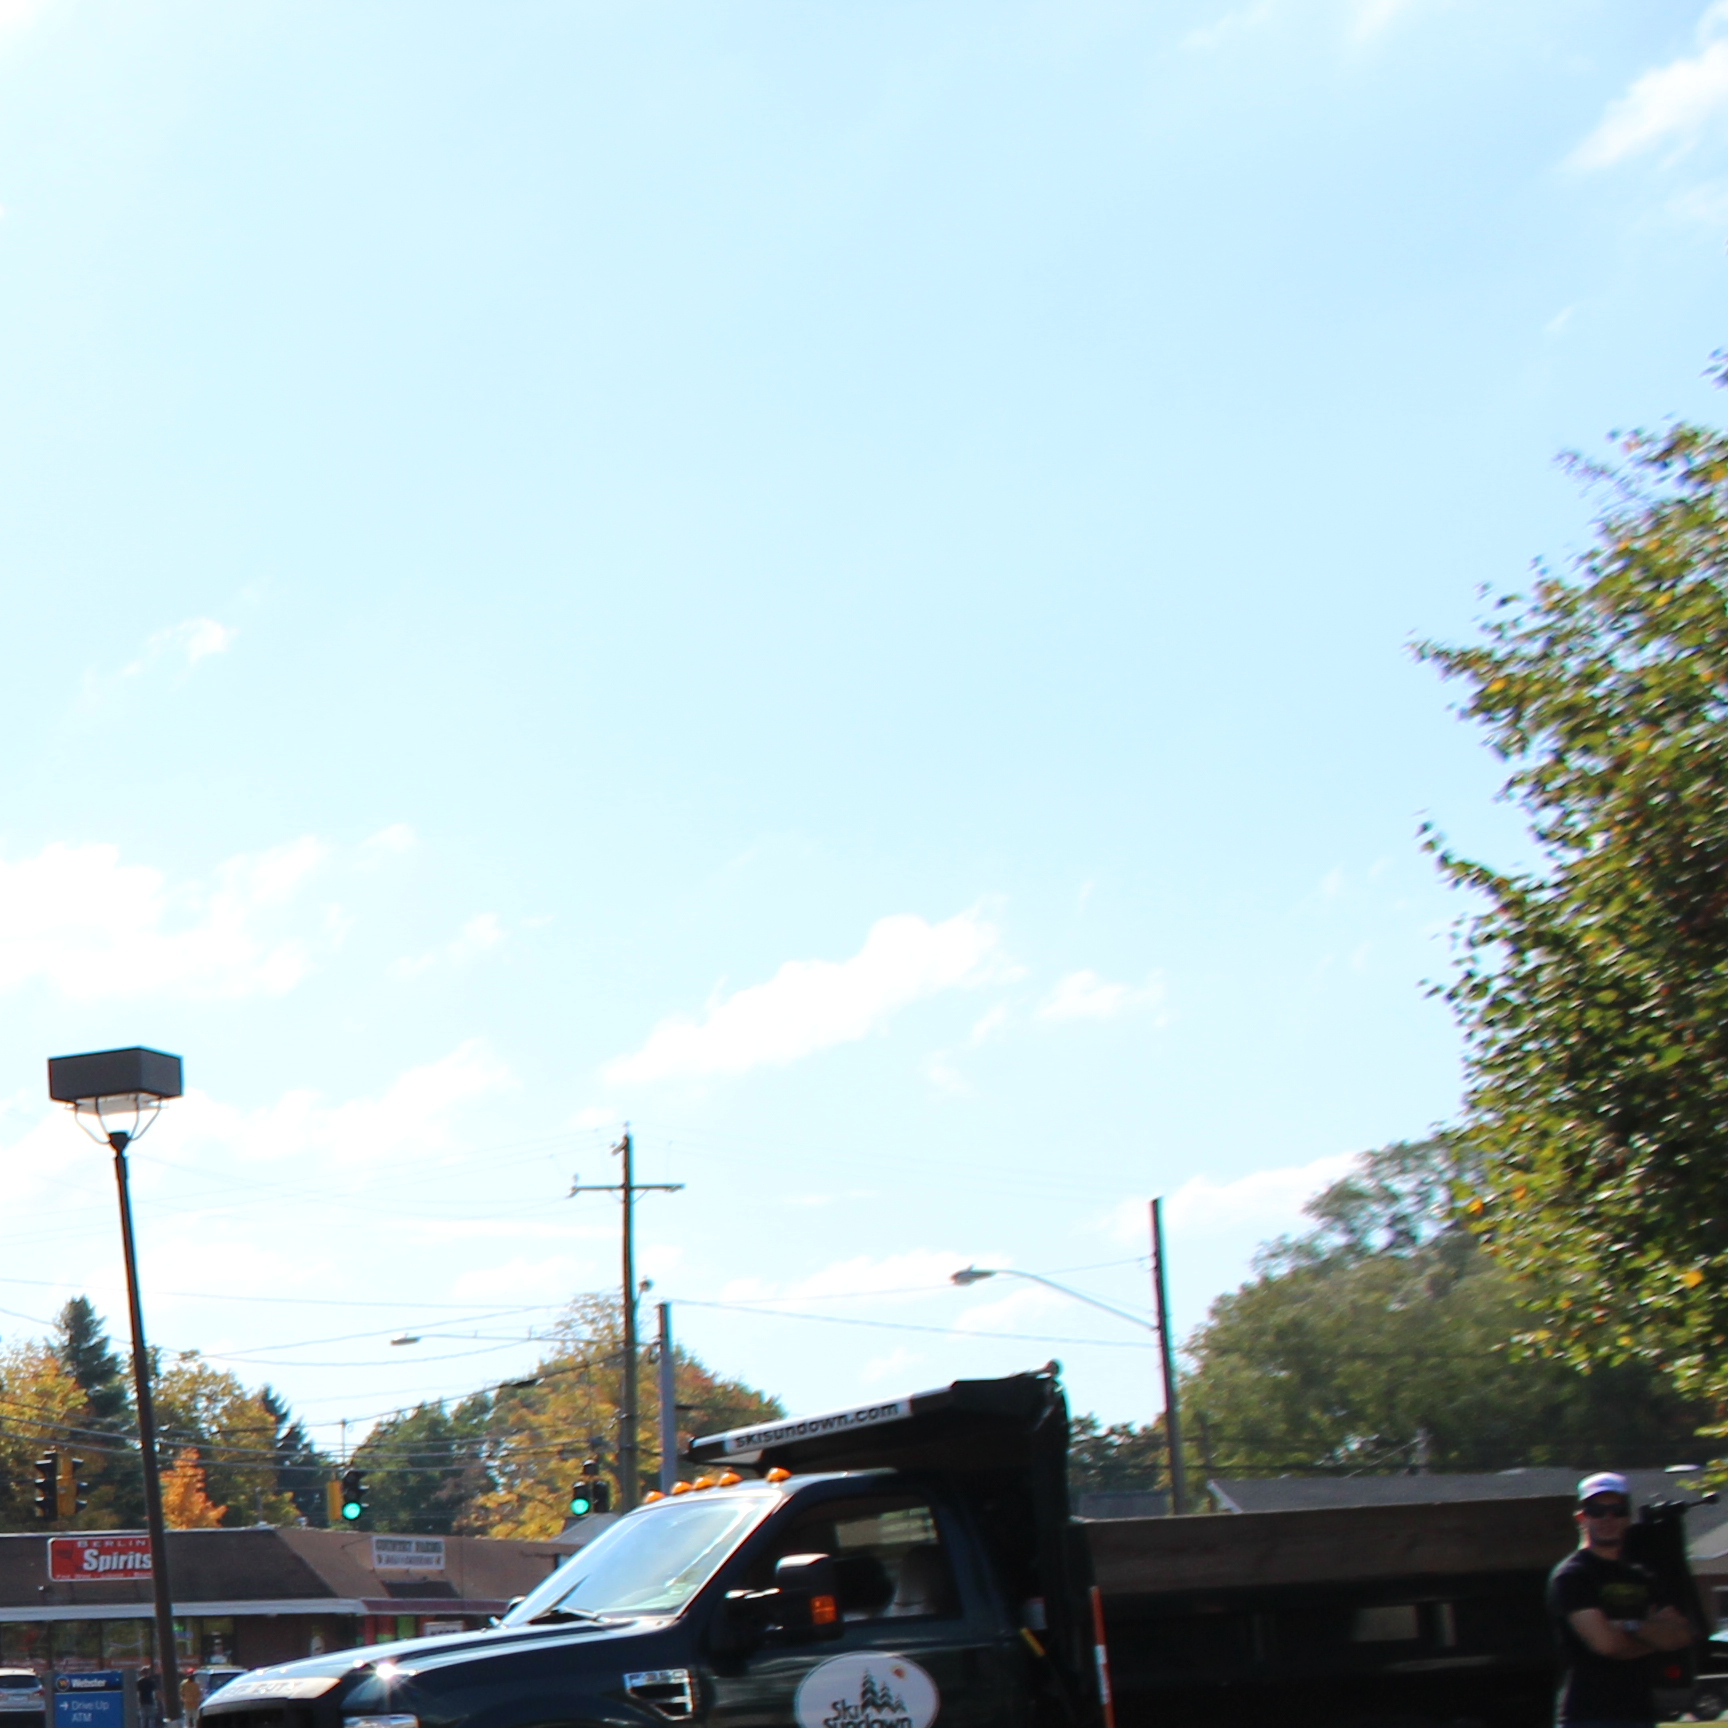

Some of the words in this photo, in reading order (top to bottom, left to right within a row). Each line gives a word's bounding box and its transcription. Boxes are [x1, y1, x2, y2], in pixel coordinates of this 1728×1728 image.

[77, 1540, 146, 1548] BERLIN
[83, 1548, 152, 1572] Spirits
[71, 1679, 106, 1688] Webster
[71, 1701, 94, 1711] Drive
[95, 1700, 111, 1712] Up
[72, 1712, 93, 1722] ATM
